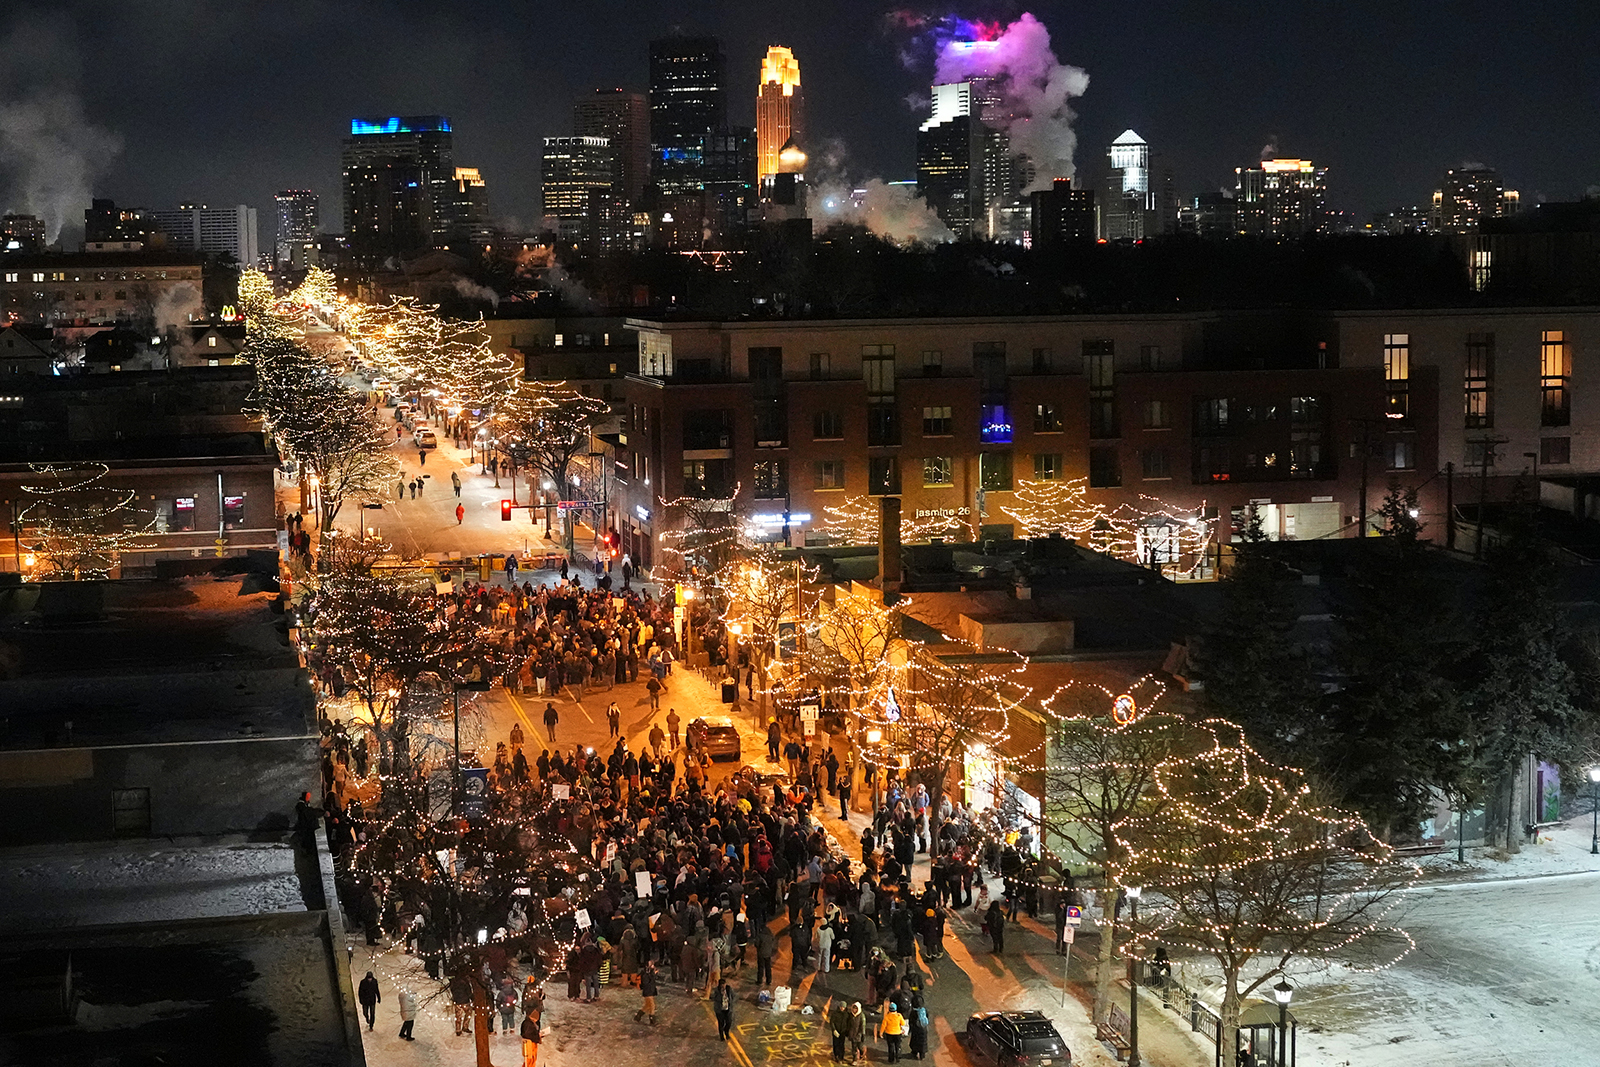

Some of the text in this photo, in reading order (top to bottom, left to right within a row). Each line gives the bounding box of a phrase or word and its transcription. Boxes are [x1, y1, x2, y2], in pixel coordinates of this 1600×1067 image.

[915, 507, 971, 519] jasmine 26
[737, 1021, 818, 1035] FUCK
[756, 1031, 814, 1043] ICE
